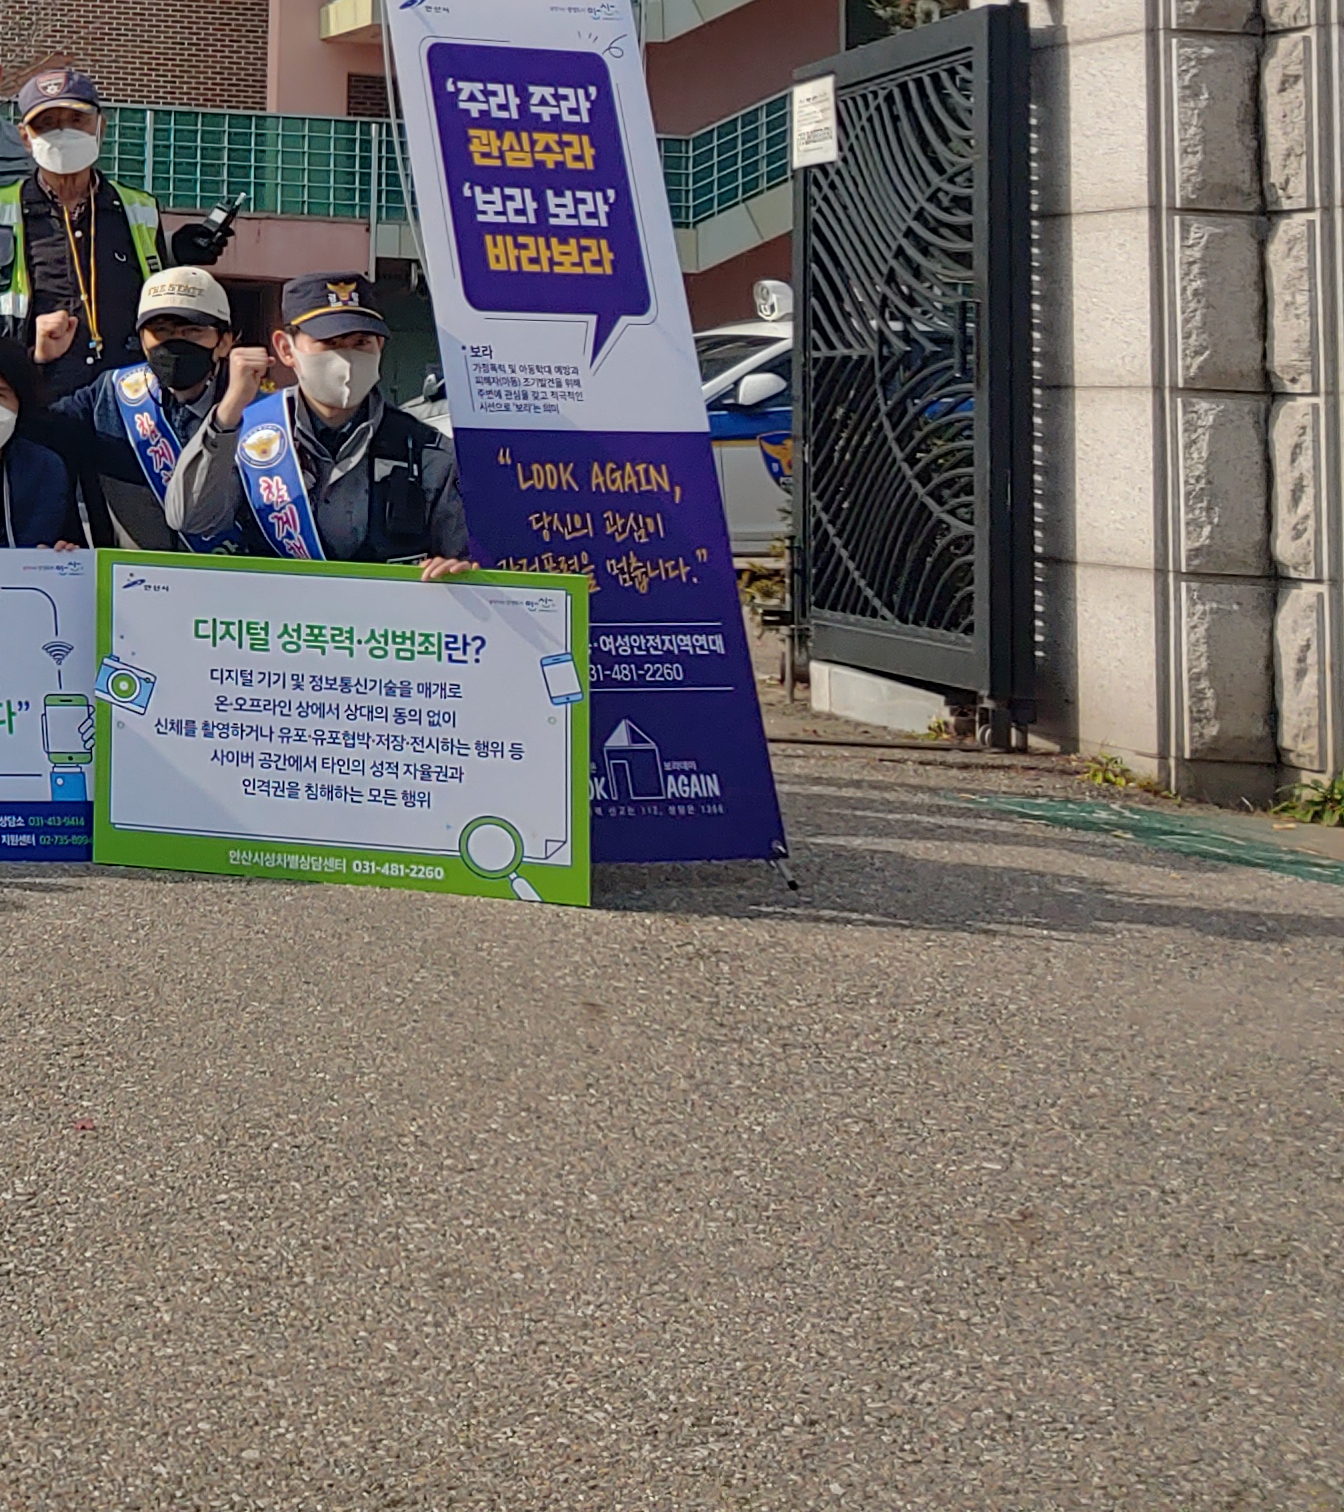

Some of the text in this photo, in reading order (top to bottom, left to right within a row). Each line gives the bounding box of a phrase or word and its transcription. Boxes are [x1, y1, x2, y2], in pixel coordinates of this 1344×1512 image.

[467, 128, 596, 171] 관심주라
[483, 234, 615, 275] 바라보라
[470, 345, 493, 359] 보라
[528, 511, 665, 542] 당신의 관심이
[193, 616, 271, 653] 디지털
[587, 634, 725, 656] ·여성안전지역연대
[210, 667, 463, 700] 디지털 기기 및 정보통신기술을 매개로
[295, 700, 340, 722] 상에서
[344, 703, 390, 723] 상대의
[392, 707, 423, 726] 동의
[426, 710, 457, 728] 없이
[154, 718, 525, 761] 신체를 촬영하거나 행위 등
[210, 750, 465, 783] 사이버 공간에서 타인의 성적 자율권과
[242, 779, 432, 810] 인격권을 침해하는 모든 행위
[667, 774, 721, 799] AGAIN
[229, 849, 445, 881] 안산시성차별상담센터 031-481-2260
